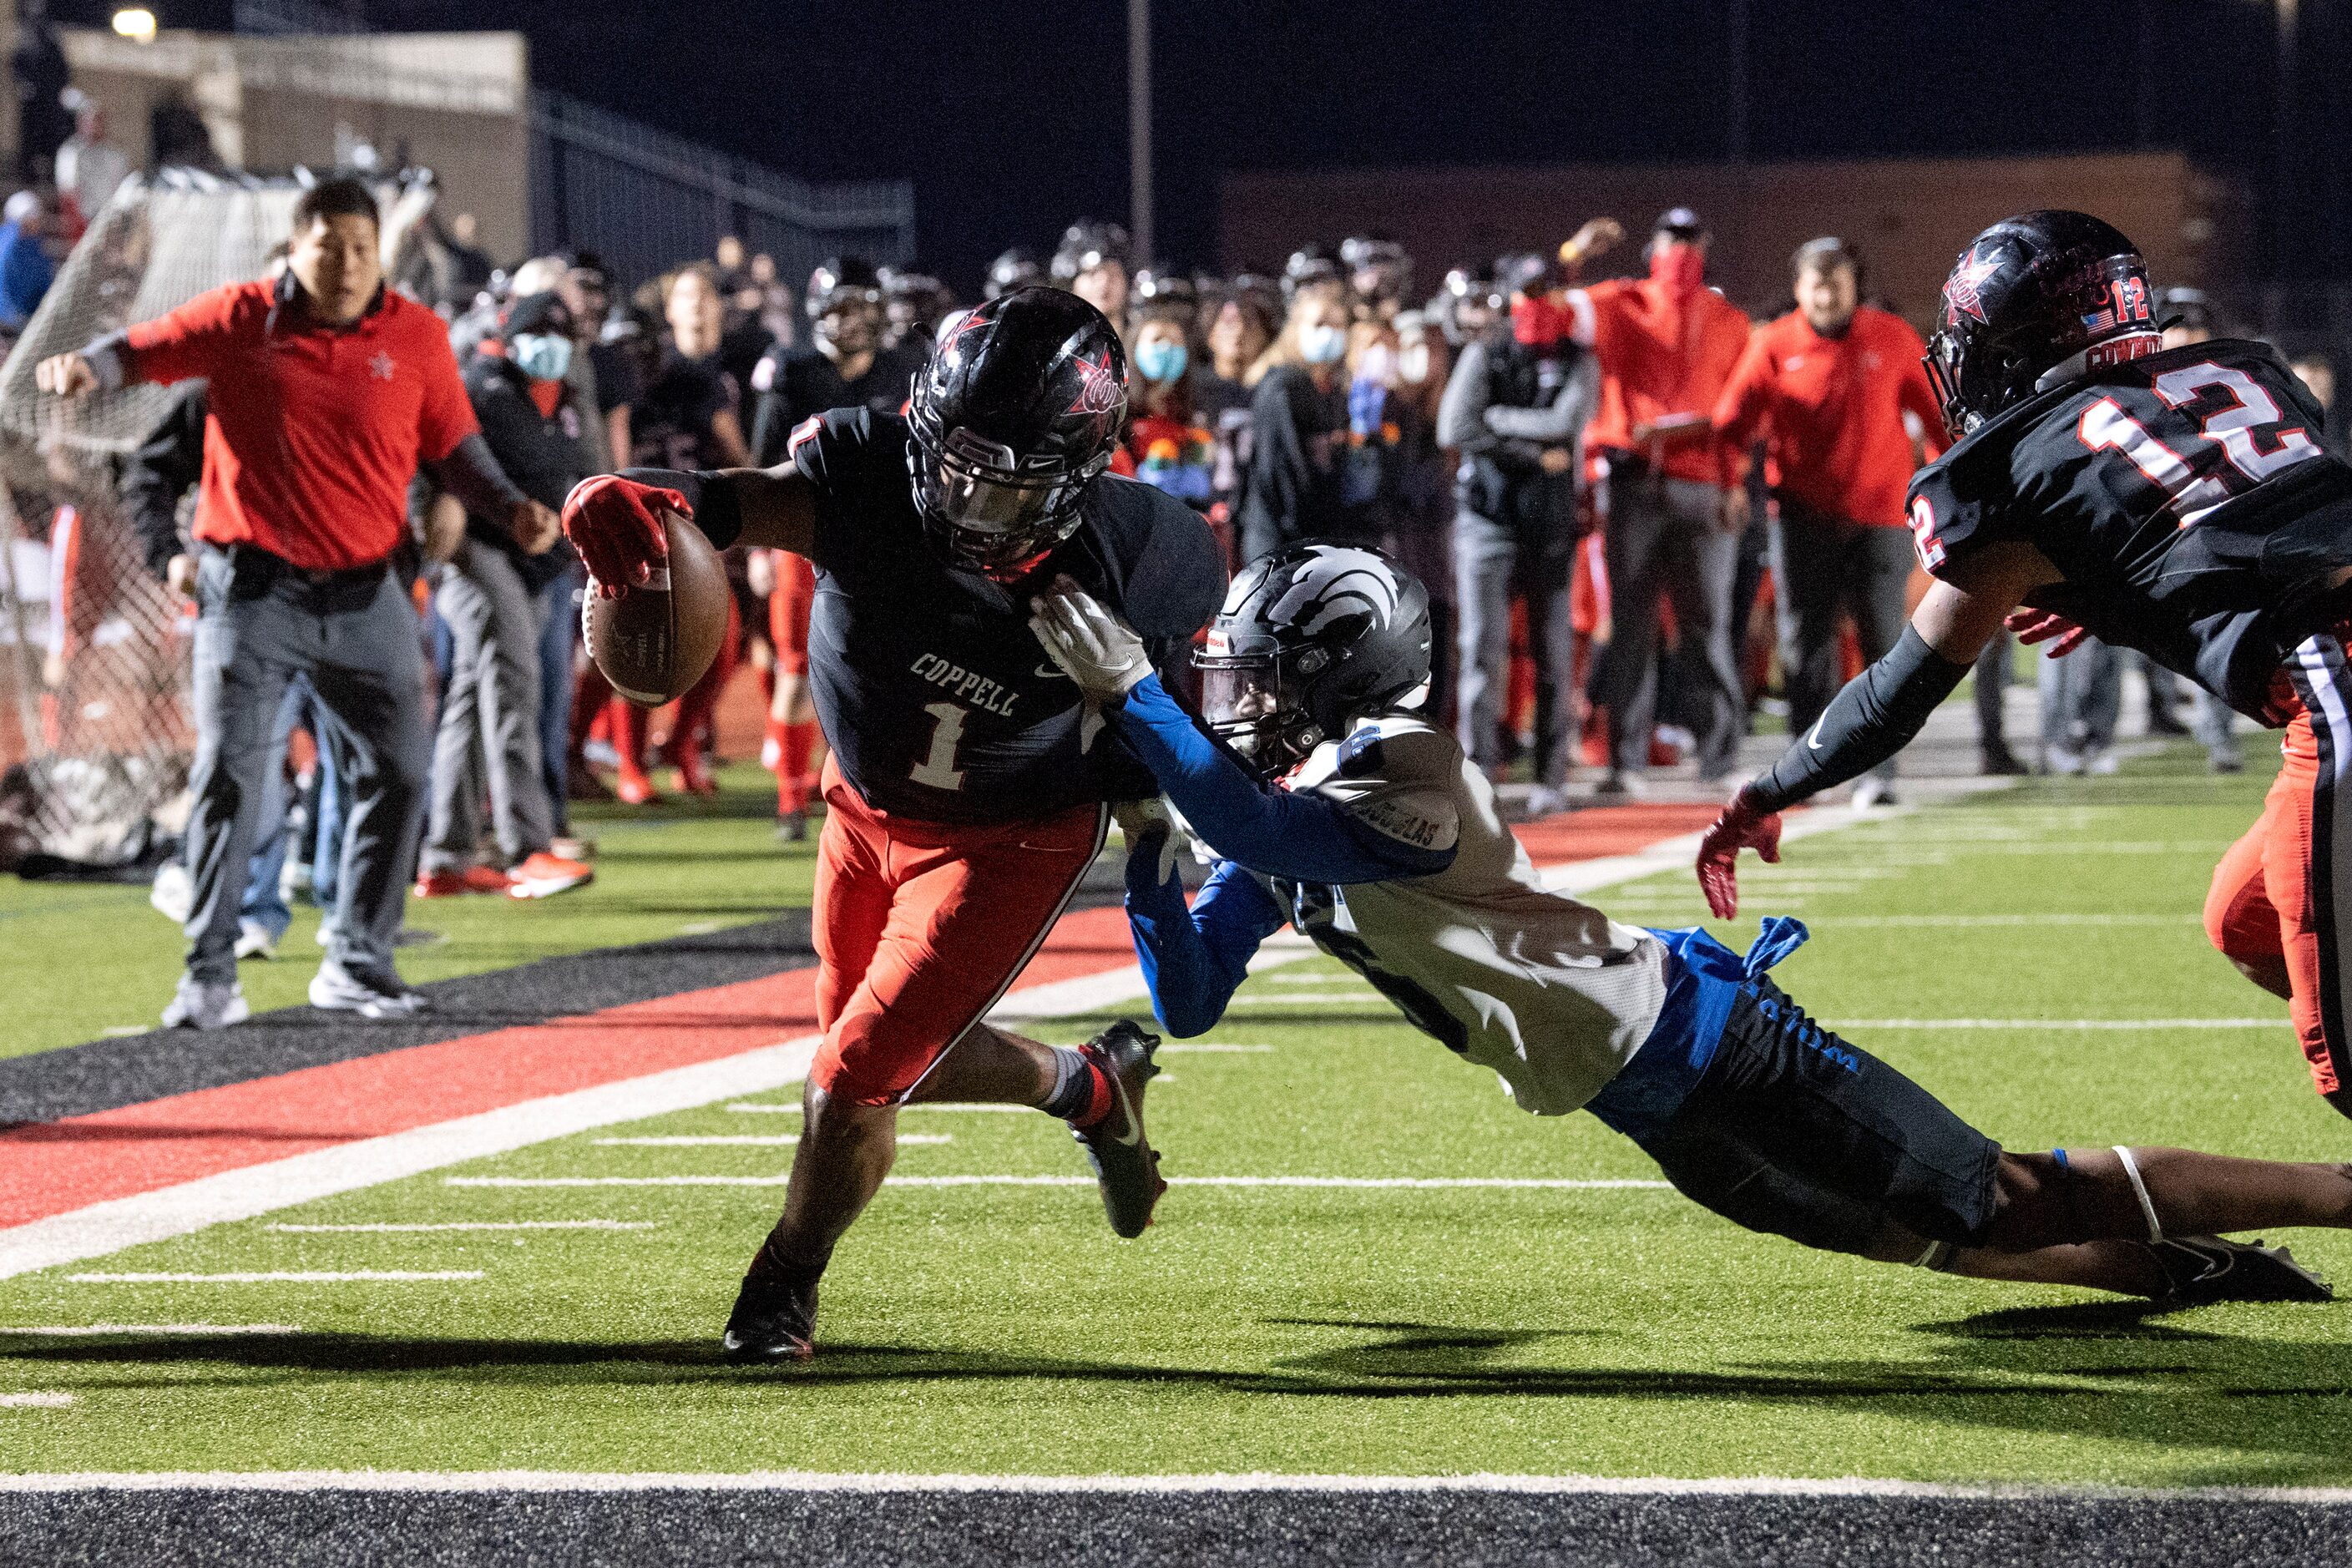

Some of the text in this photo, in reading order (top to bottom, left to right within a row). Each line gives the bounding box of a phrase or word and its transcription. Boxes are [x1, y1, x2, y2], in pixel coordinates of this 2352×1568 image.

[2111, 276, 2149, 324] 12
[2077, 359, 2324, 531] 12
[910, 652, 1019, 717] COPPELL
[907, 701, 969, 792] 1
